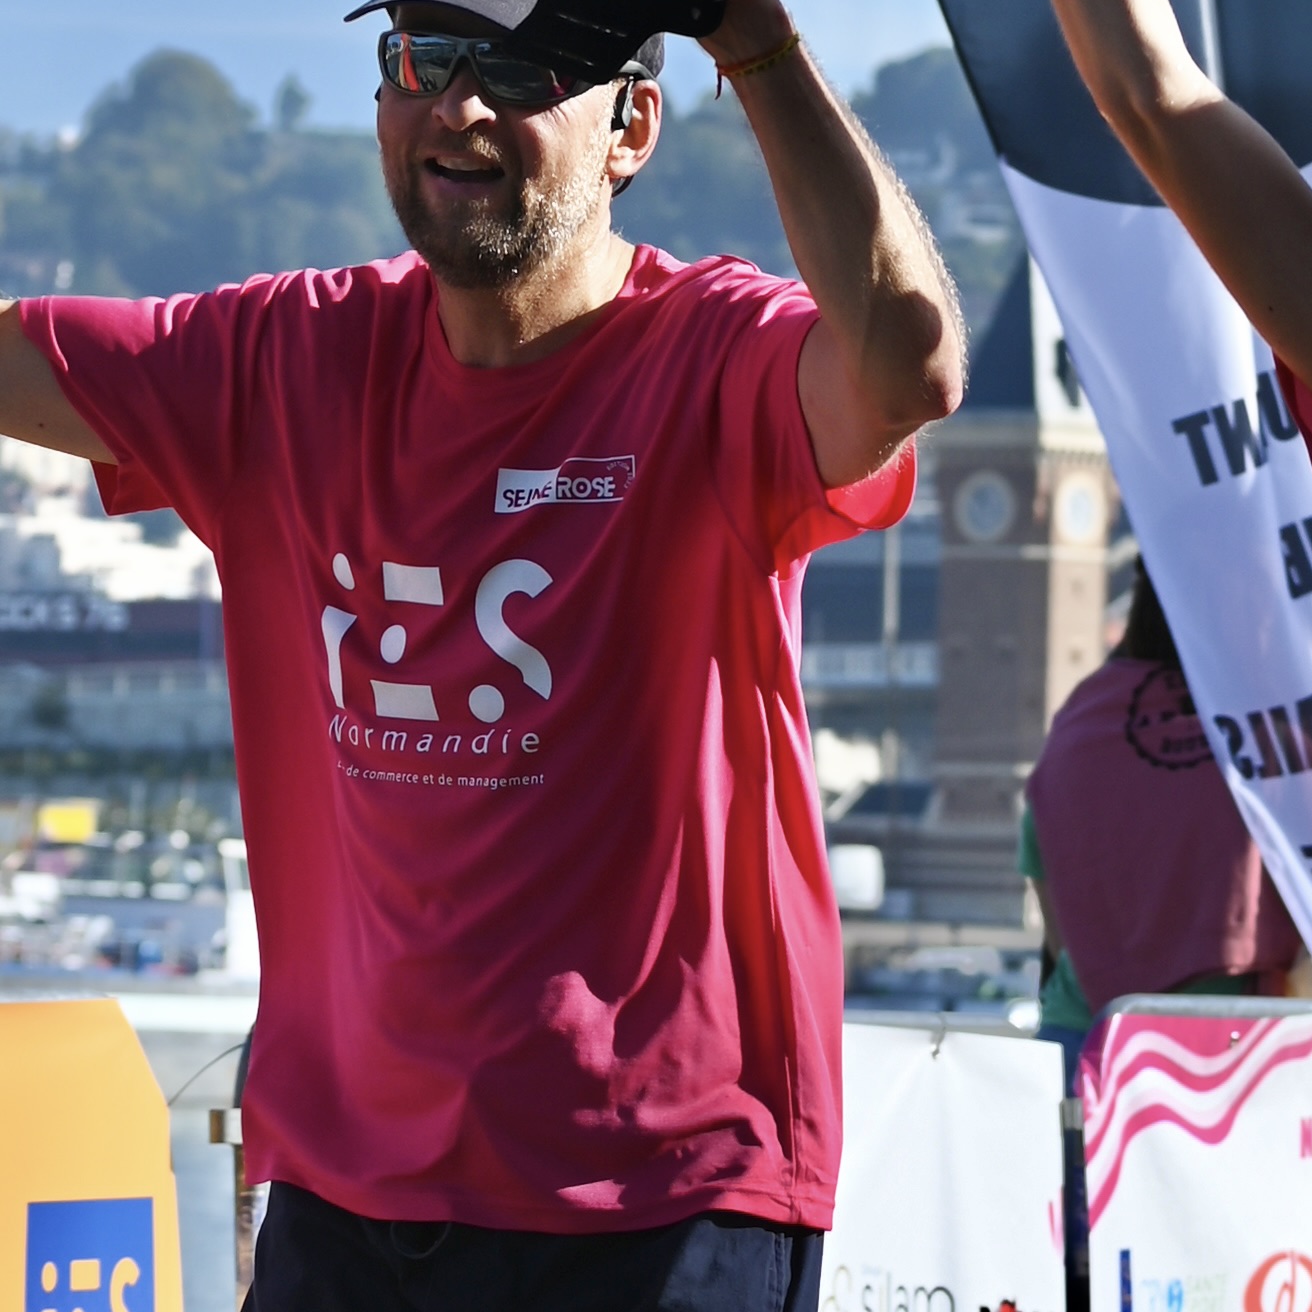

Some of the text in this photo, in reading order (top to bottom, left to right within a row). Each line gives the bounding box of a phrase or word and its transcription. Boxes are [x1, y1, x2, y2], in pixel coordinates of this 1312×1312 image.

[557, 476, 616, 499] ROSE
[328, 714, 540, 754] Normandie
[363, 768, 418, 785] commerce
[423, 774, 435, 786] et
[438, 773, 453, 787] de
[457, 774, 544, 790] management
